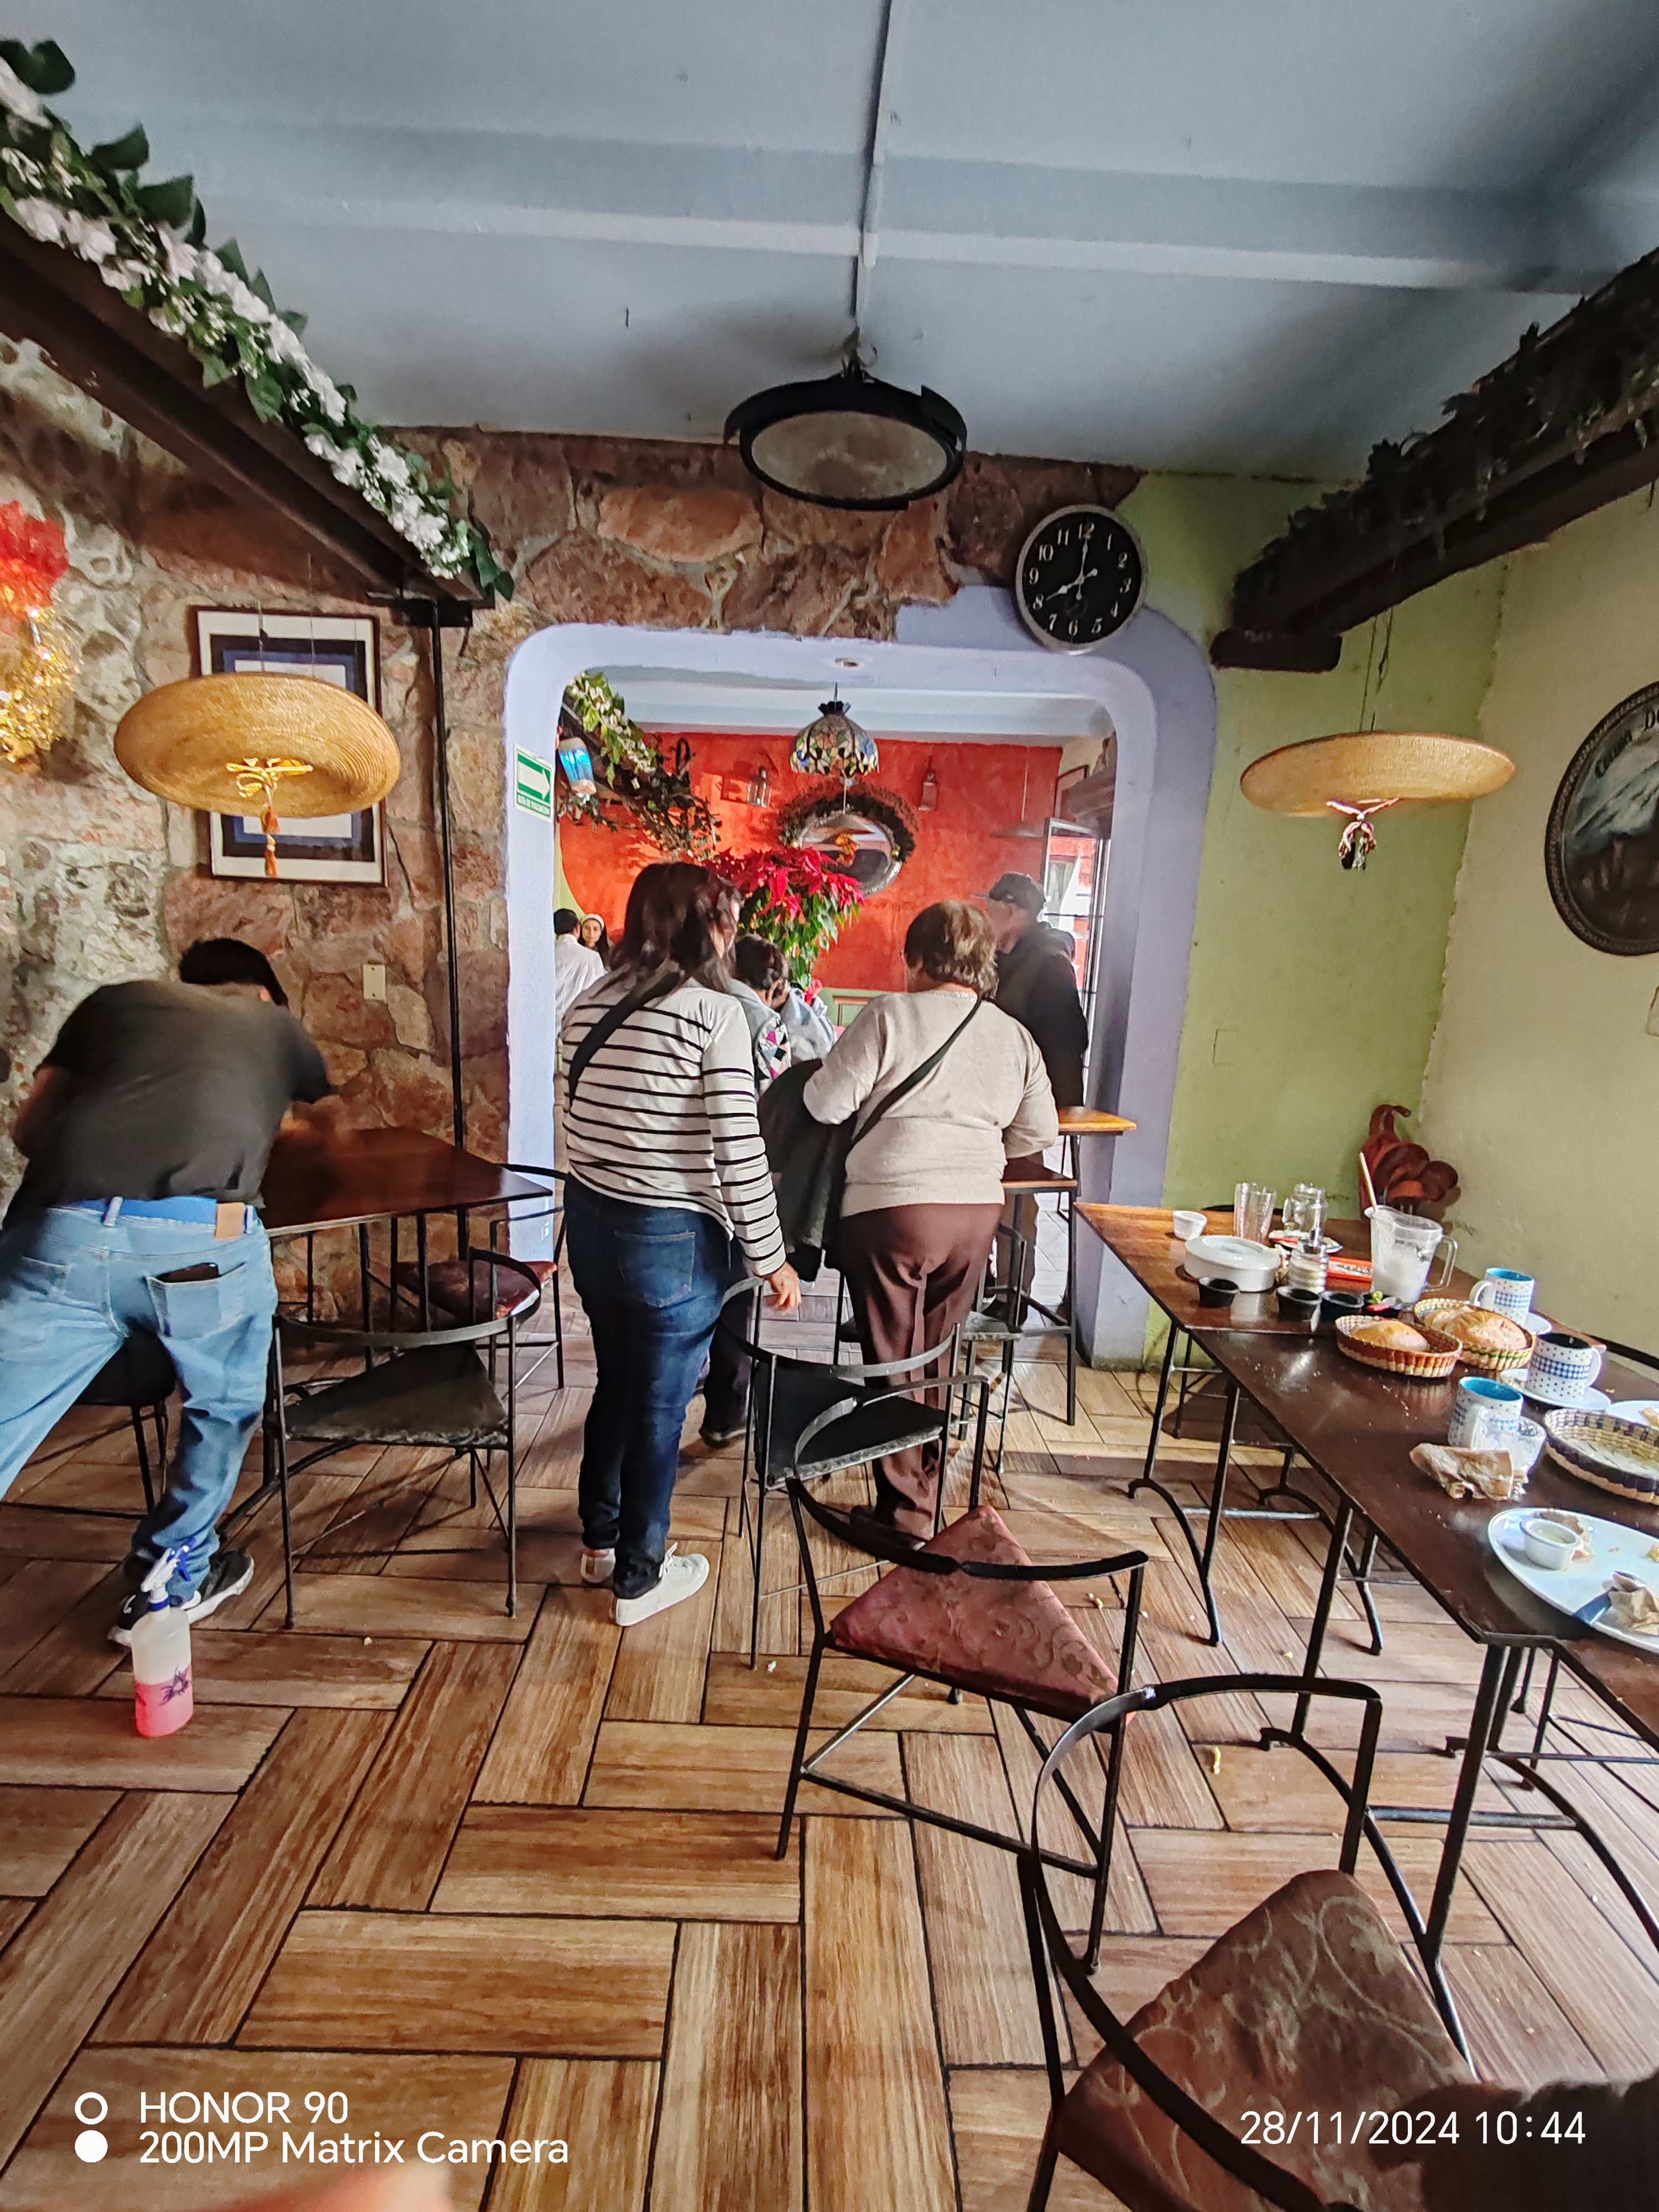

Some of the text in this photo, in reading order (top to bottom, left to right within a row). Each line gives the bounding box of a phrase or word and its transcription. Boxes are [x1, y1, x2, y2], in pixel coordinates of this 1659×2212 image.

[1057, 528, 1070, 546] 11
[1078, 522, 1095, 540] 12
[1107, 533, 1112, 551] 1
[1038, 544, 1054, 561] 10
[1117, 552, 1128, 568] 2
[1029, 567, 1039, 585] 9
[1119, 577, 1132, 594] 3
[1032, 593, 1044, 611] 8
[1110, 601, 1119, 618] 4
[1048, 613, 1058, 631] 7
[1068, 619, 1078, 637] 6
[1091, 617, 1103, 634] 5
